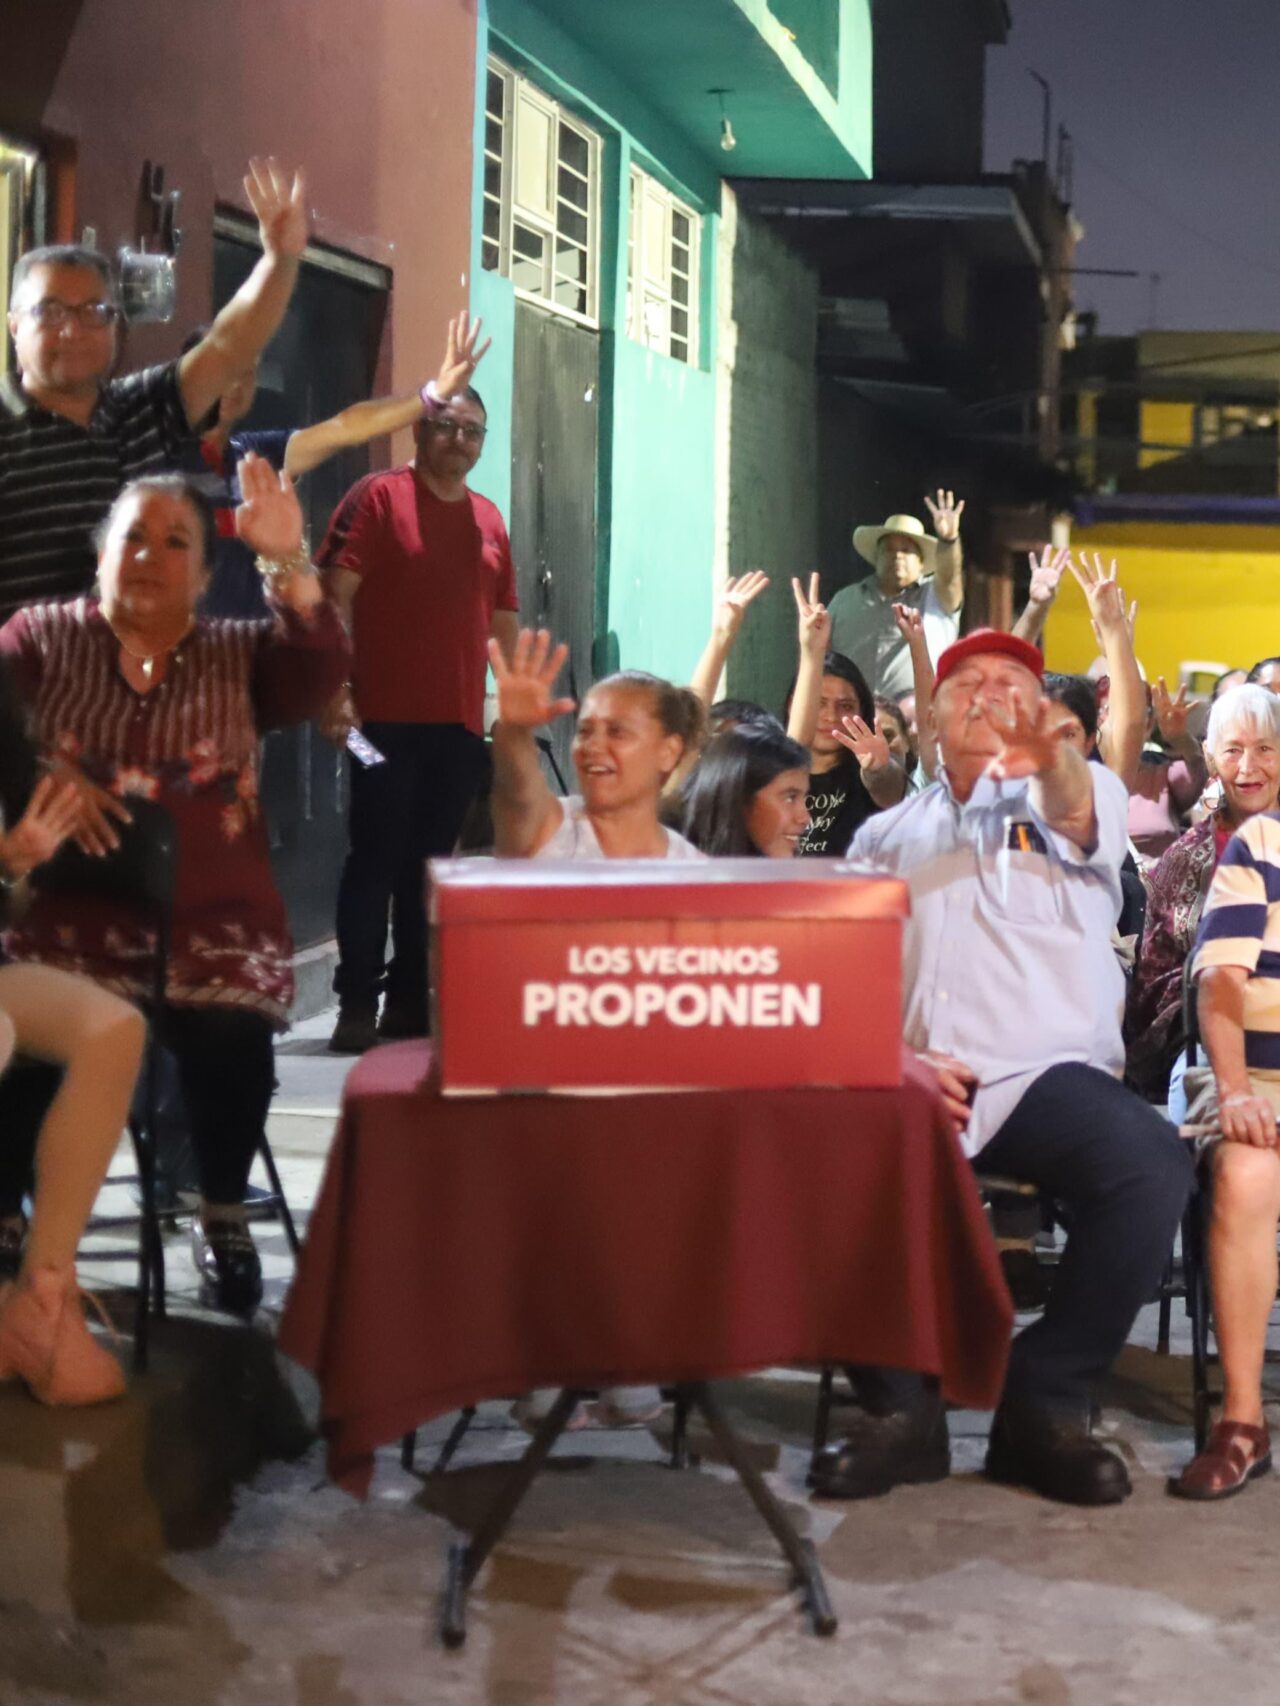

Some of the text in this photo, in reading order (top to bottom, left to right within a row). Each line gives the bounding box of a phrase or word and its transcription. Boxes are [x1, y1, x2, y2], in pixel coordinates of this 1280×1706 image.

[569, 946, 779, 976] LOS VECINOS
[522, 983, 821, 1028] PROPONEN
